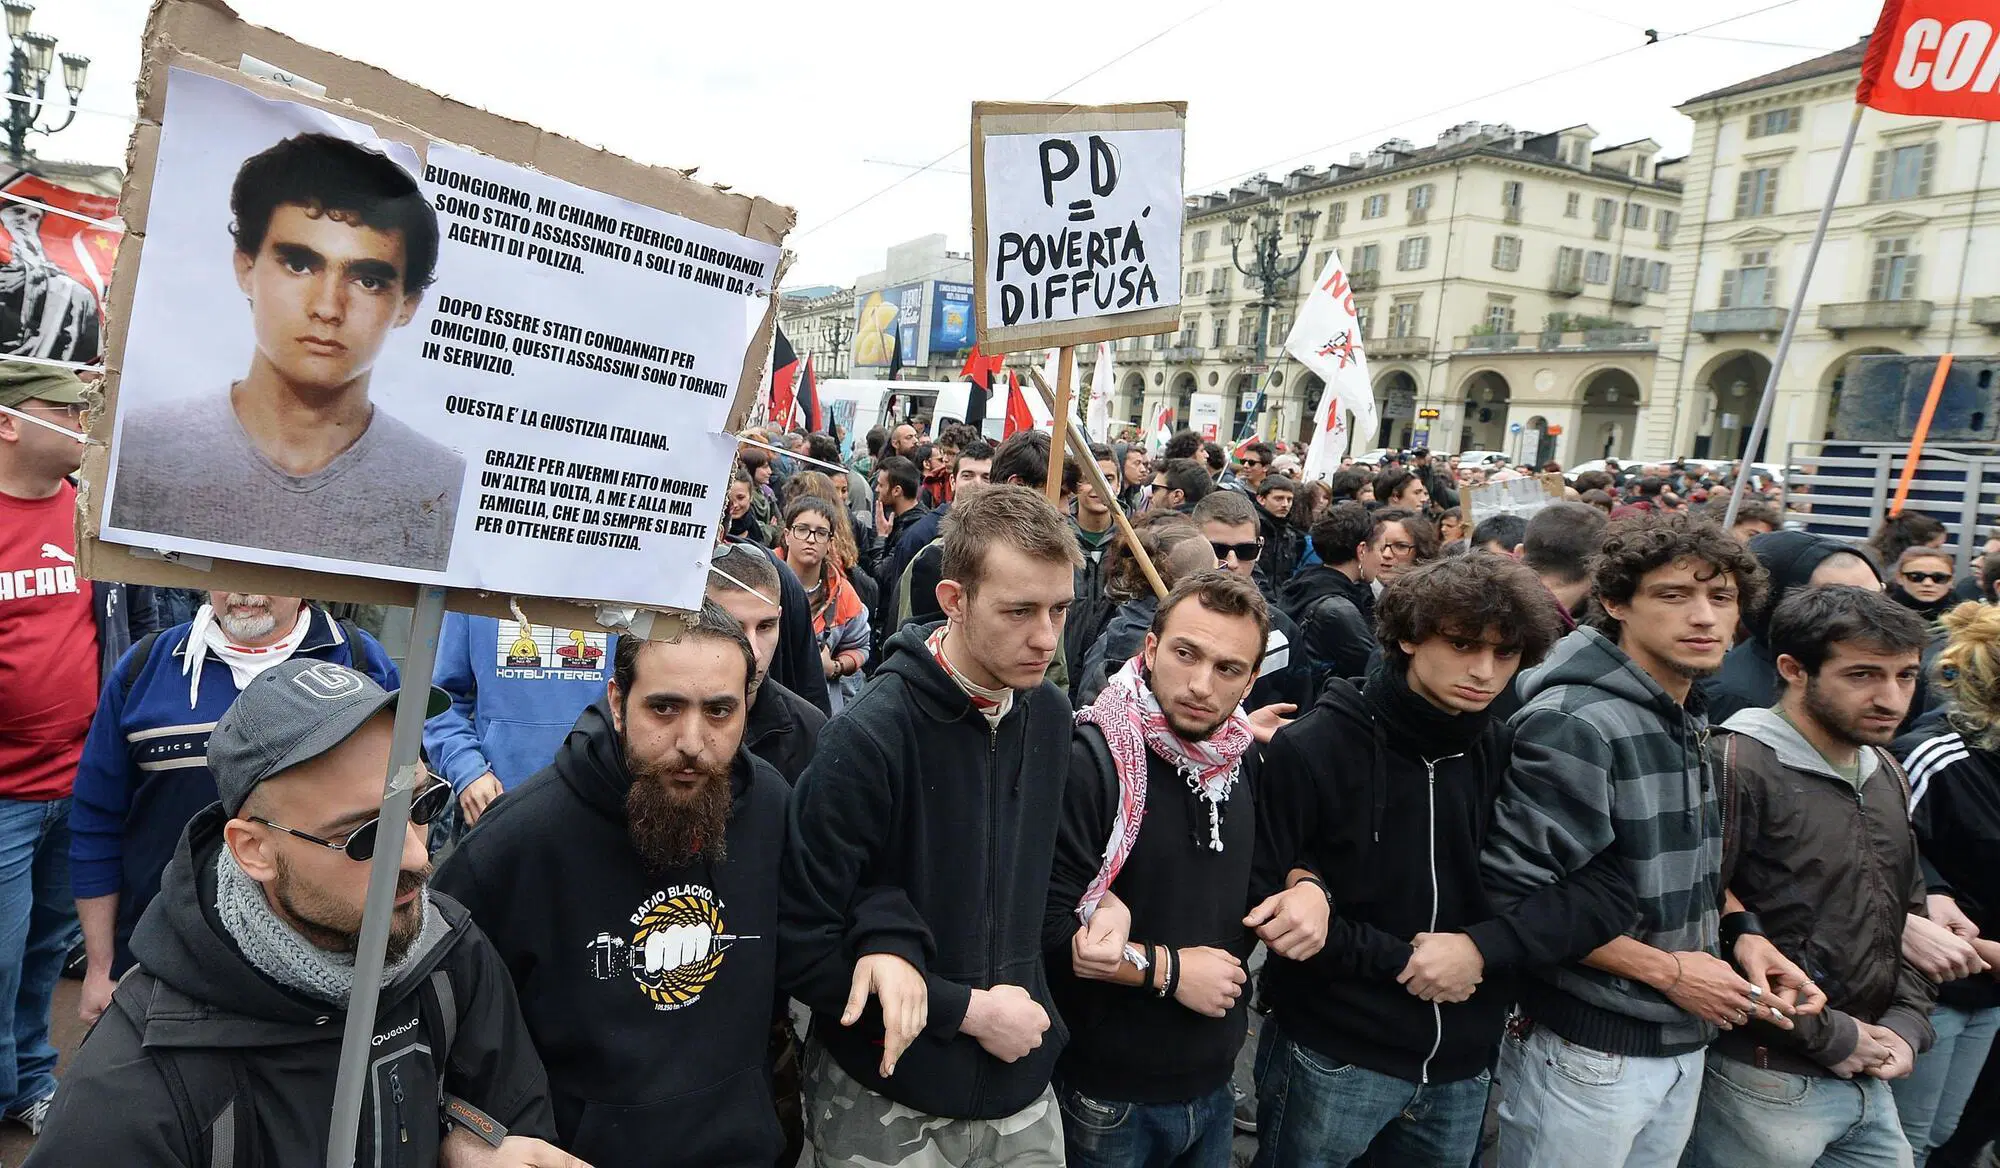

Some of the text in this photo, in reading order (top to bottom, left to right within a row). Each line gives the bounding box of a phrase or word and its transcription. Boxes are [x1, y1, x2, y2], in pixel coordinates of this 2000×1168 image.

[1039, 135, 1119, 207] PD
[424, 164, 764, 278] BUONGIORNO, MI CHIAMO FEDERICO ALDROVANDI.
[435, 194, 754, 296] SONO STATO ASSASSINATO A SOLI 18 ANNI DA 4
[448, 223, 584, 274] AGENTI DI POLIZIA.
[1000, 264, 1159, 327] DIFFUSA
[422, 341, 514, 376] IN SERVIZIO.
[438, 296, 695, 370] DOPO ESSERE STATI CONDANNATI PER
[431, 319, 728, 399] OMICIDIO, QUESTI ASSASSINI SONO TORNATI
[446, 395, 669, 451] QUESTA E' LA GIUSTIZIA ITALIANA.
[481, 471, 692, 517] UN'ALTRA VOLTA, A ME E ALLA MIA
[485, 450, 708, 499] GRAZIE PER AVERMI FATTO MORIRE
[475, 516, 641, 551] PER OTTENERE GIUSTIZIA.
[479, 494, 707, 539] FAMIGLIA, CHE DA SEMPRE SI BATTE
[629, 884, 726, 926] RADIO BLACKOT
[371, 1018, 420, 1046] Quechua
